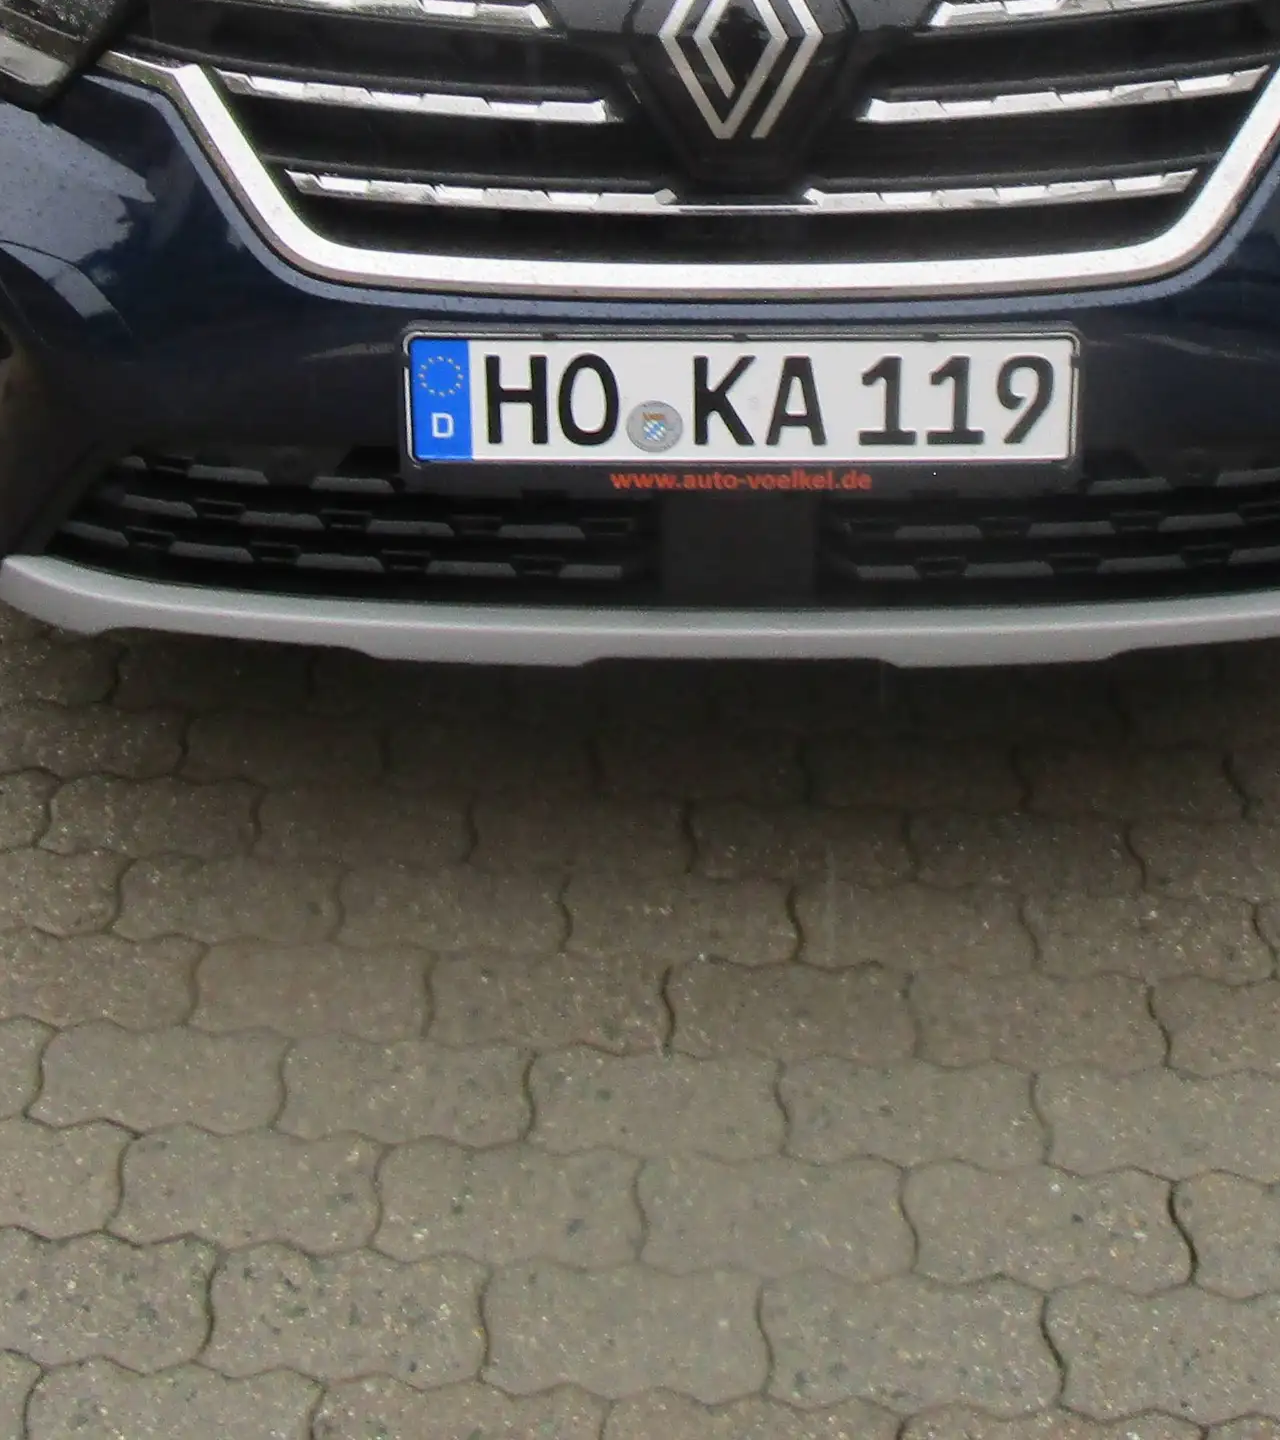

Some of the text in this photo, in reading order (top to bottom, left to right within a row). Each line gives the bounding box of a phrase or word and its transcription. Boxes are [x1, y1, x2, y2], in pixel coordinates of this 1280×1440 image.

[484, 353, 620, 446] HO
[693, 356, 827, 446] KA
[858, 355, 1055, 446] 119
[431, 412, 455, 438] D
[609, 468, 873, 490] www.auto-voelkel.de
